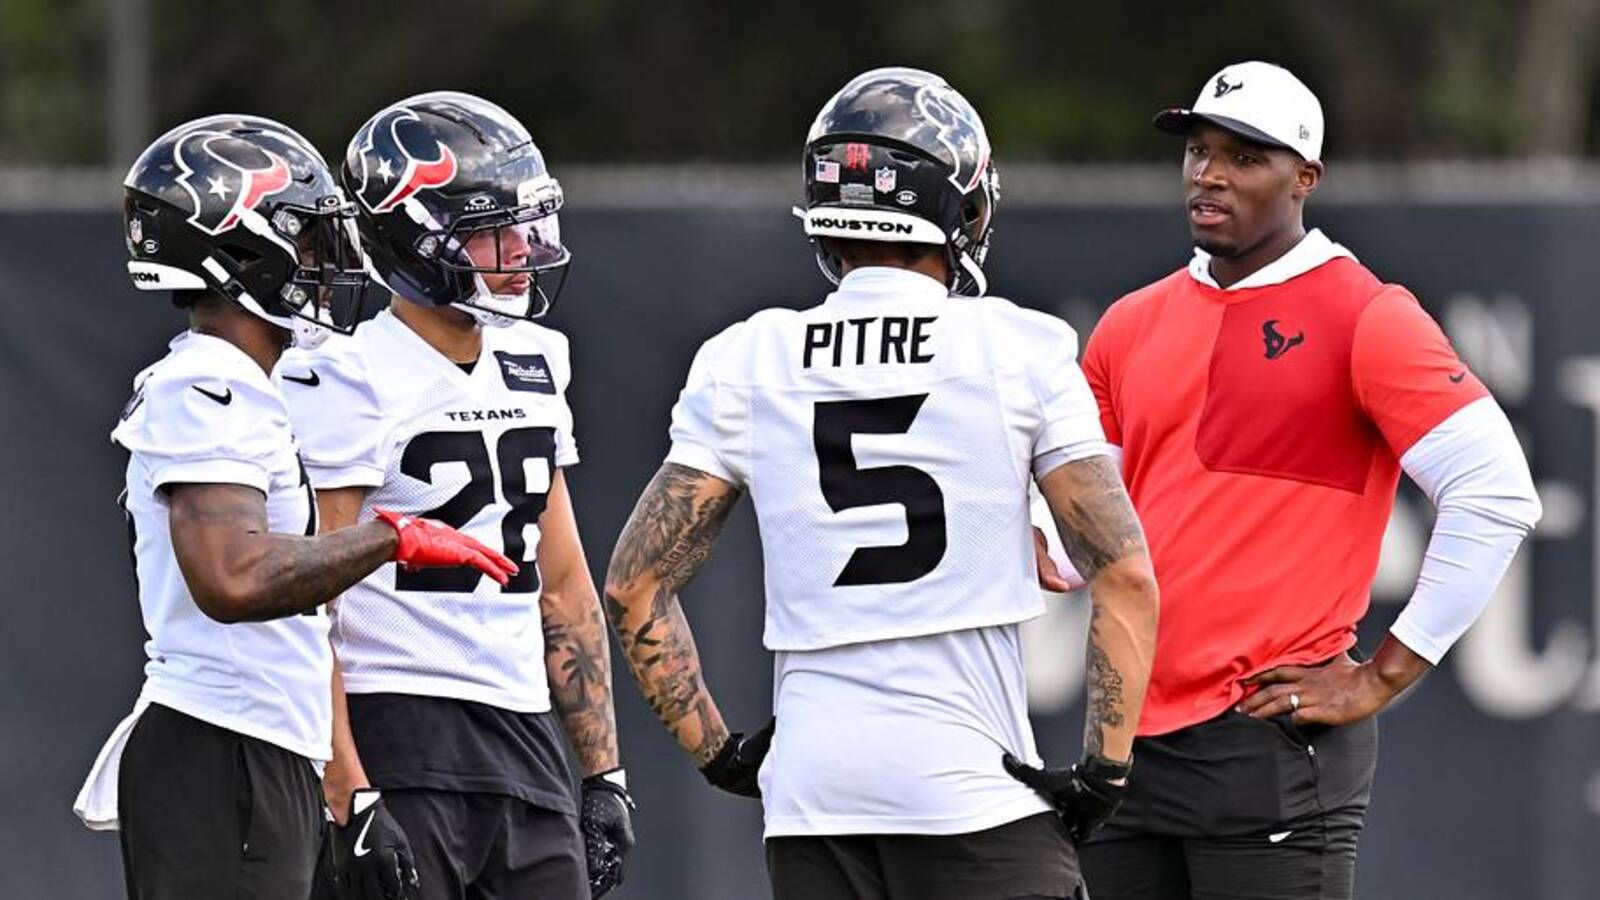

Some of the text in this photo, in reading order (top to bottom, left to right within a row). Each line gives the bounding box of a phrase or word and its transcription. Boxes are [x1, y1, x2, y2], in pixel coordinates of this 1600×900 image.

[811, 218, 913, 234] HOUSTON
[803, 316, 939, 369] PITRE
[445, 408, 526, 422] TEXANS
[395, 426, 557, 593] 28
[812, 392, 948, 587] 5
